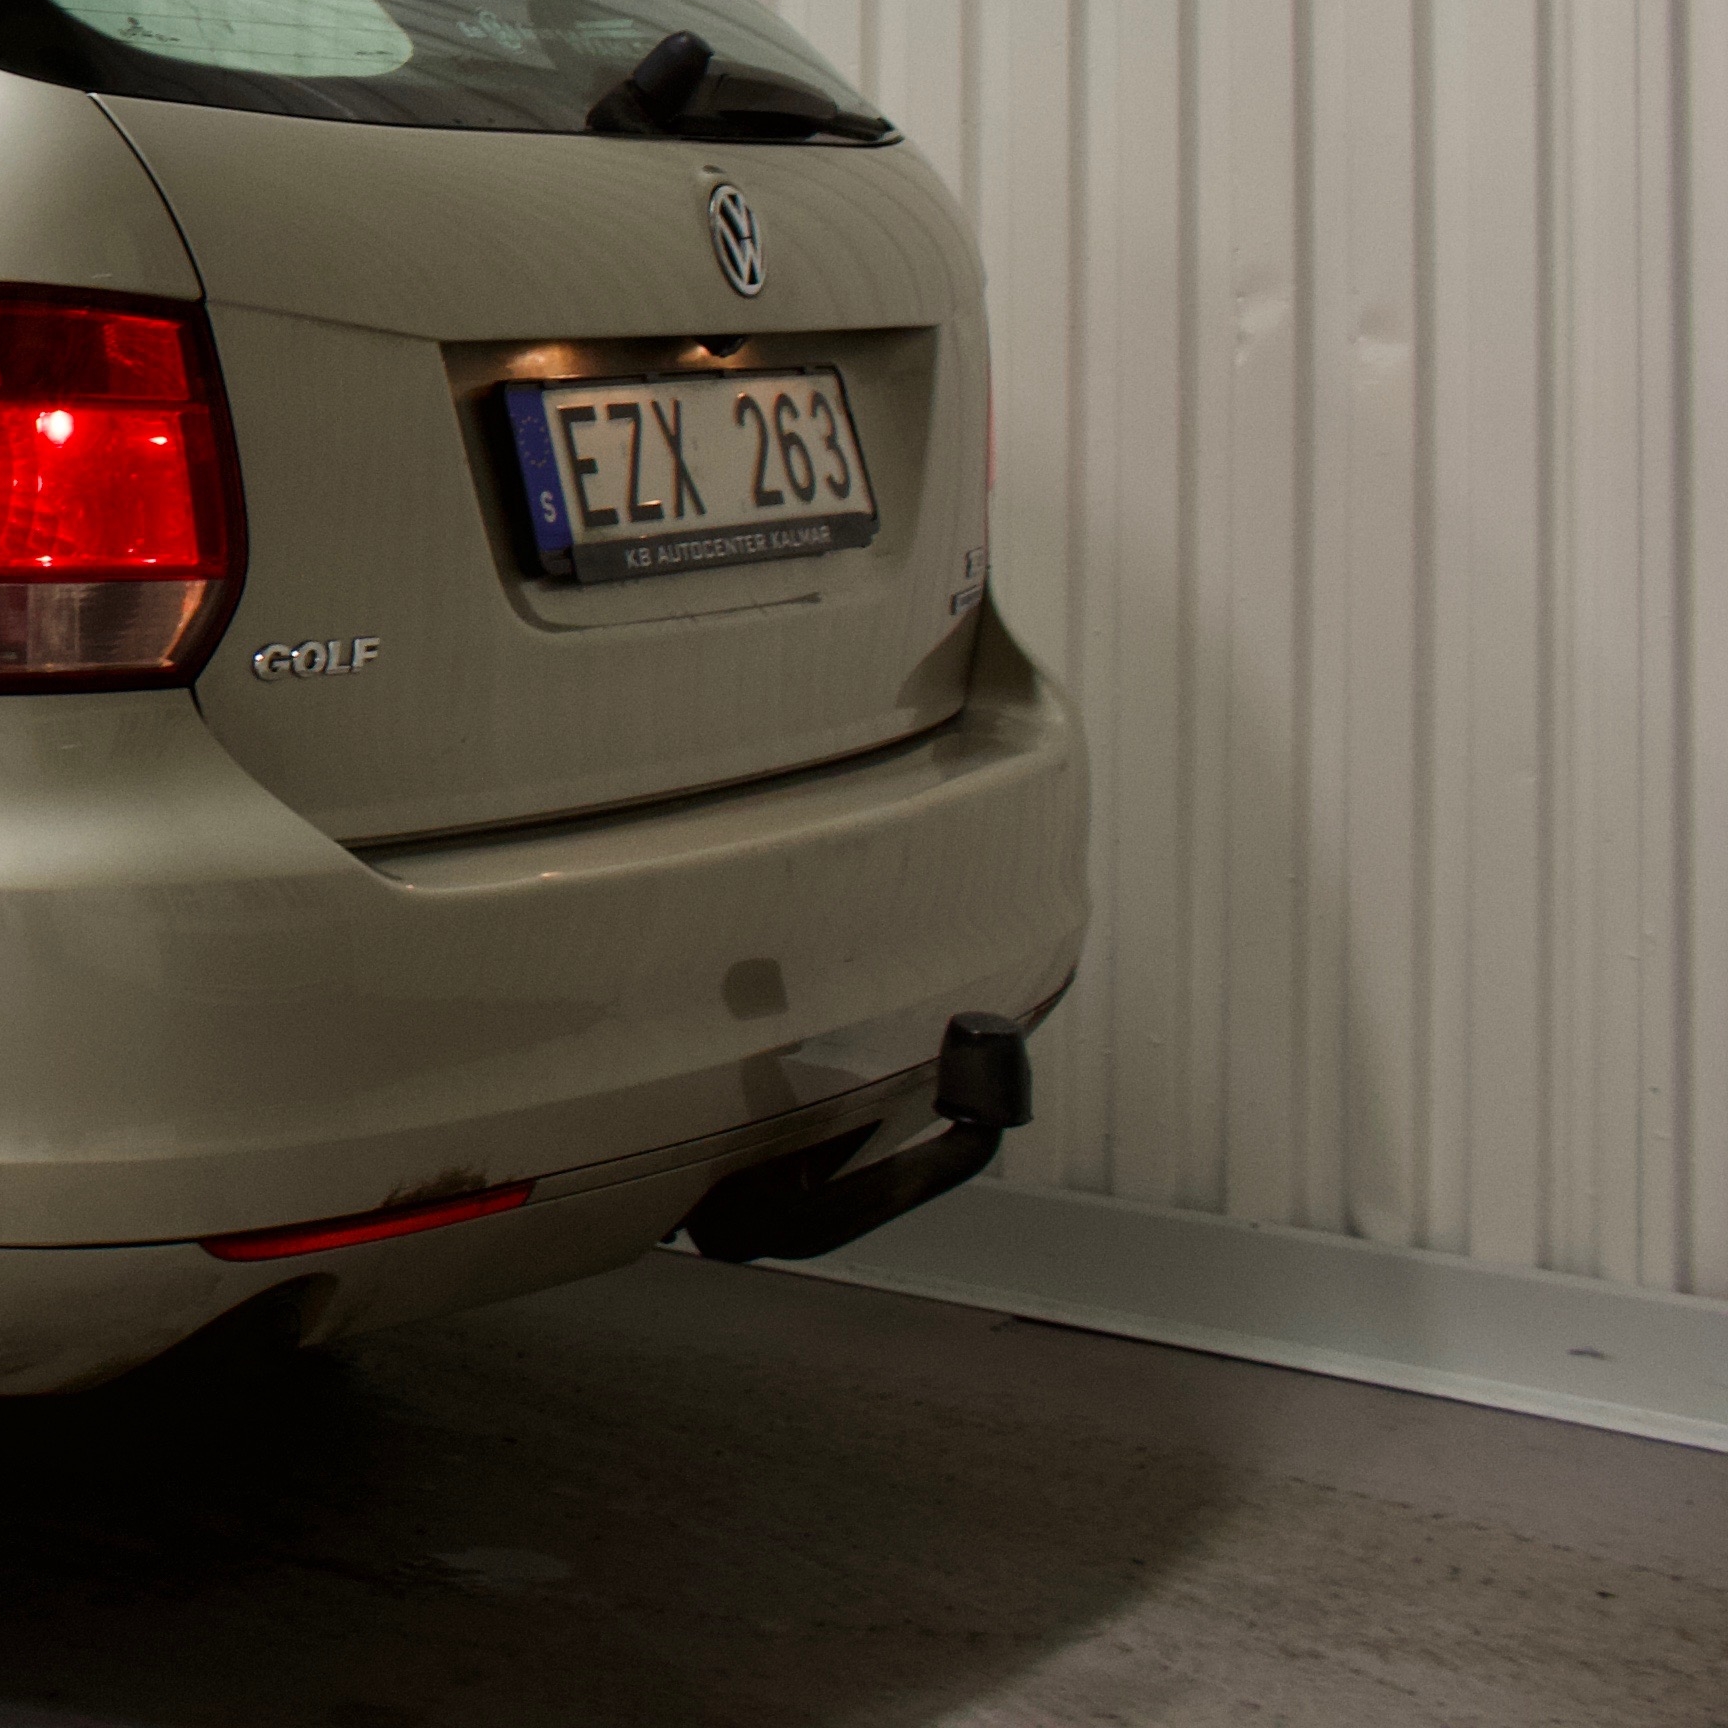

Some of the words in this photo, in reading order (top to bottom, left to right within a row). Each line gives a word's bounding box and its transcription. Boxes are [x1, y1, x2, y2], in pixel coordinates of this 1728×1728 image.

[556, 398, 706, 528] EZX
[733, 390, 850, 507] 263
[539, 490, 557, 522] S
[623, 547, 652, 569] KB
[657, 534, 768, 566] AUTOCENTER
[771, 525, 832, 549] KALMAR
[252, 636, 381, 681] GOLF
